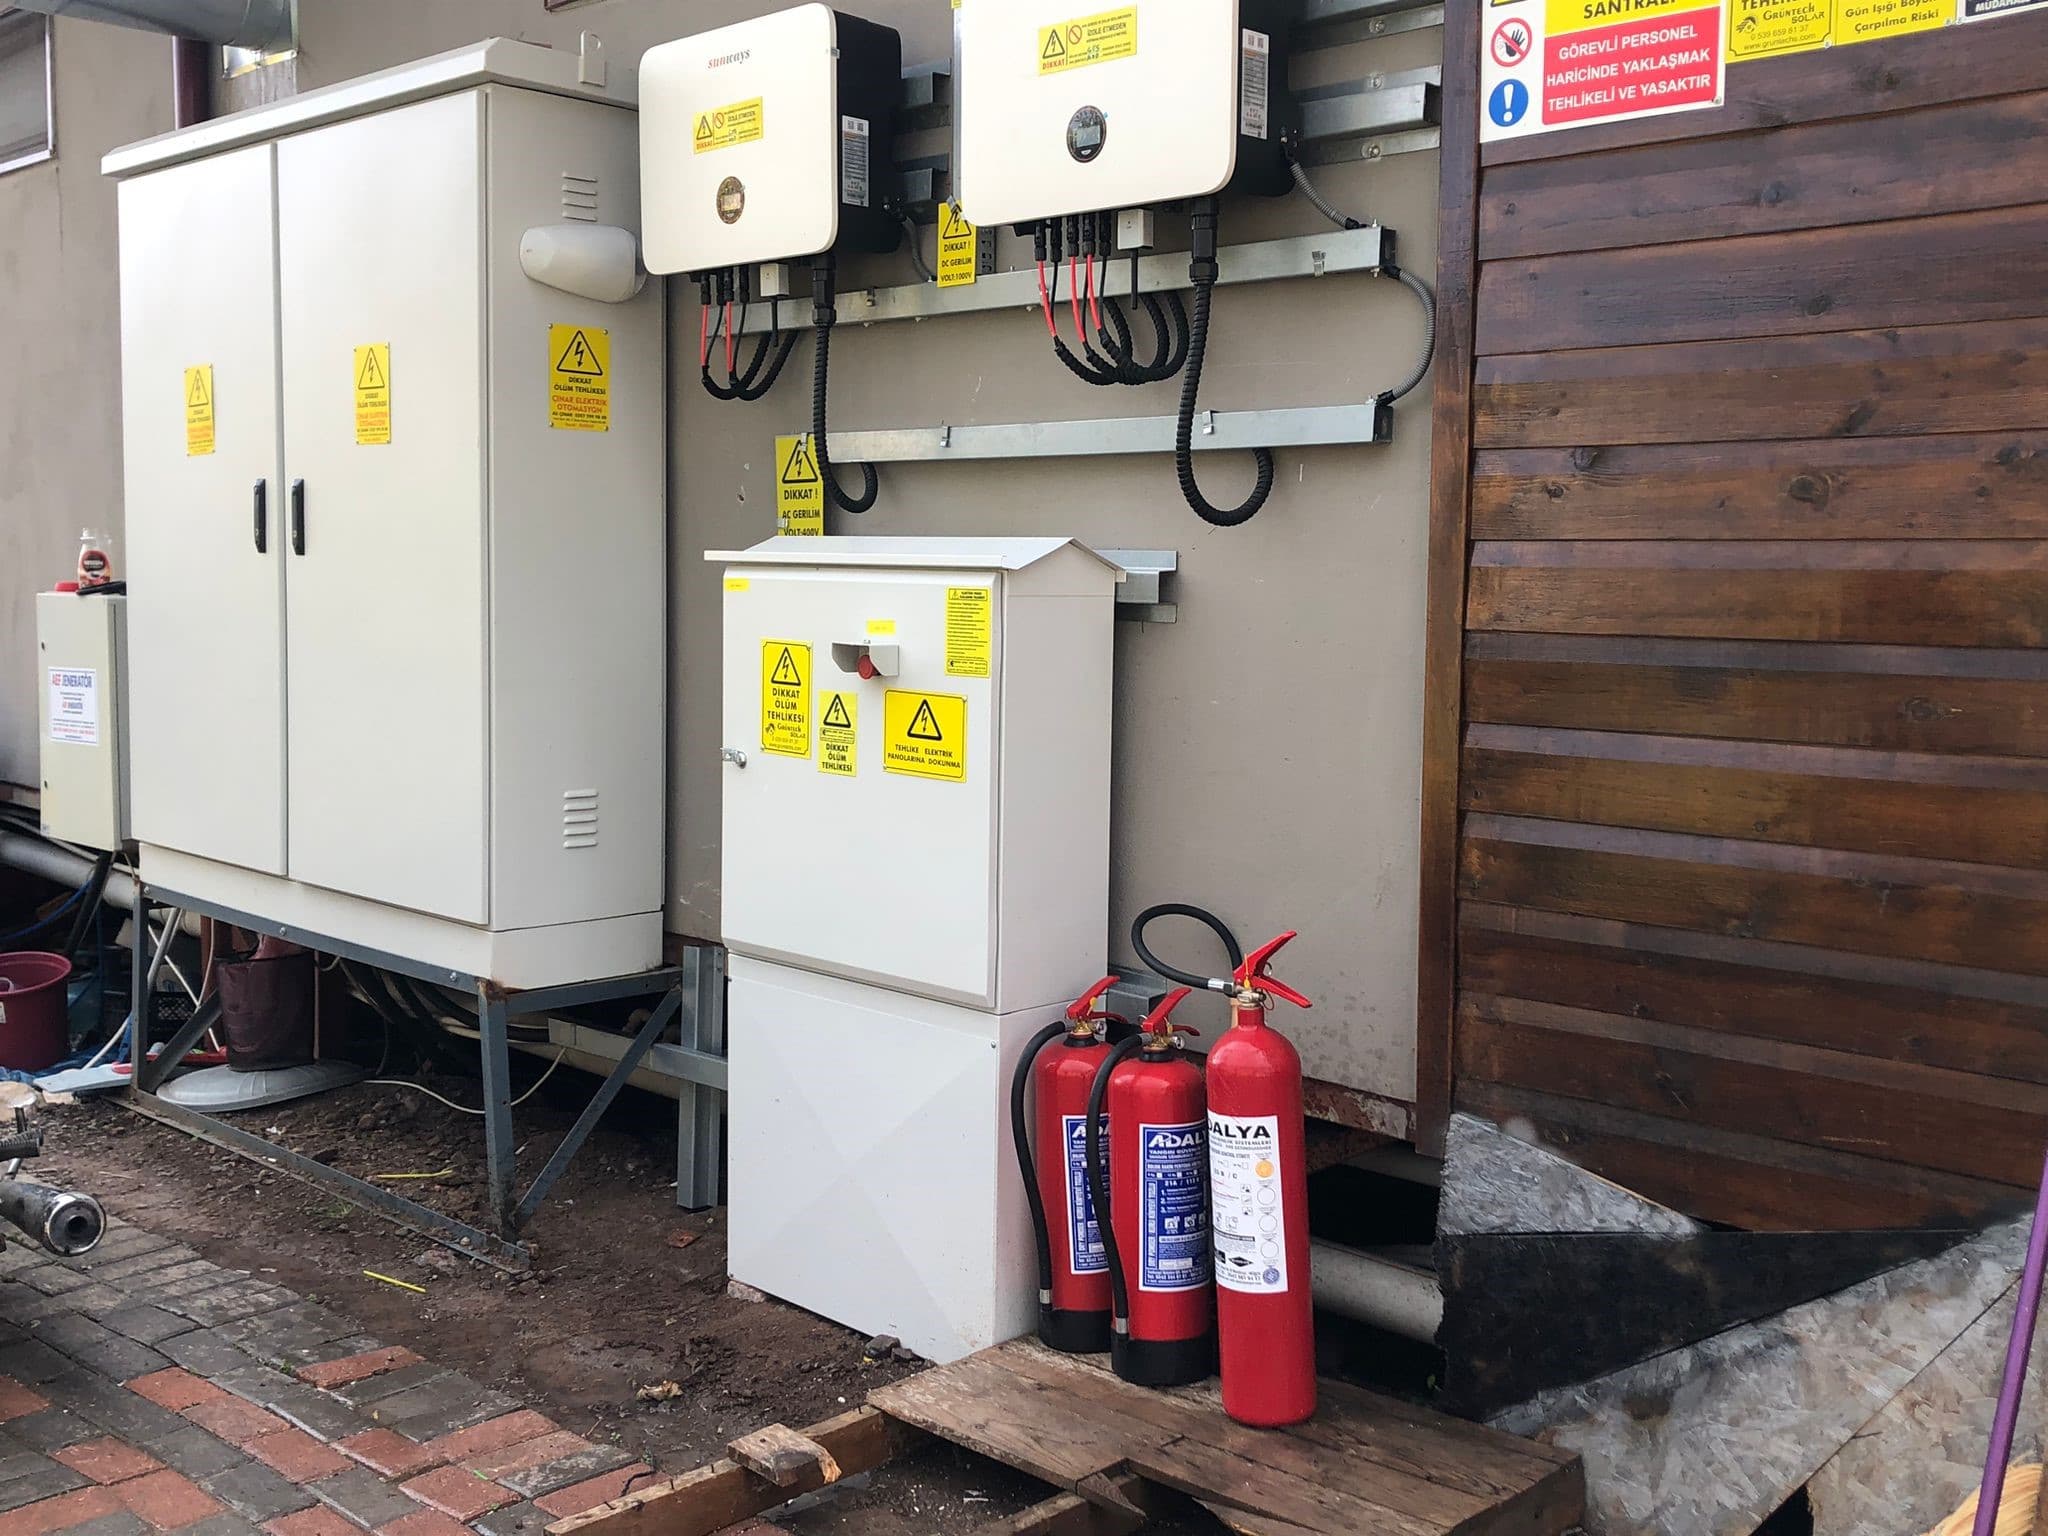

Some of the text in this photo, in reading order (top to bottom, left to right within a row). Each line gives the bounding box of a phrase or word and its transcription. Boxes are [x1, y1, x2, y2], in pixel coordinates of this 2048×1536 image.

[1791, 12, 1825, 24] SOLAR
[1845, 7, 1869, 17] Gün
[1854, 9, 1940, 34] Çarpılma Riski
[1559, 25, 1698, 60] GÖREVLİ PERSONEL
[707, 49, 751, 69] sunways
[1546, 48, 1711, 87] HARİCİNDE YAKLAŞMAK
[1548, 73, 1711, 112] TEHLİKELİ VE YASAKTIR
[774, 698, 797, 710] ÖLÜM
[767, 709, 805, 723] TEHLİKESİ
[928, 758, 961, 768] DOKUNMA
